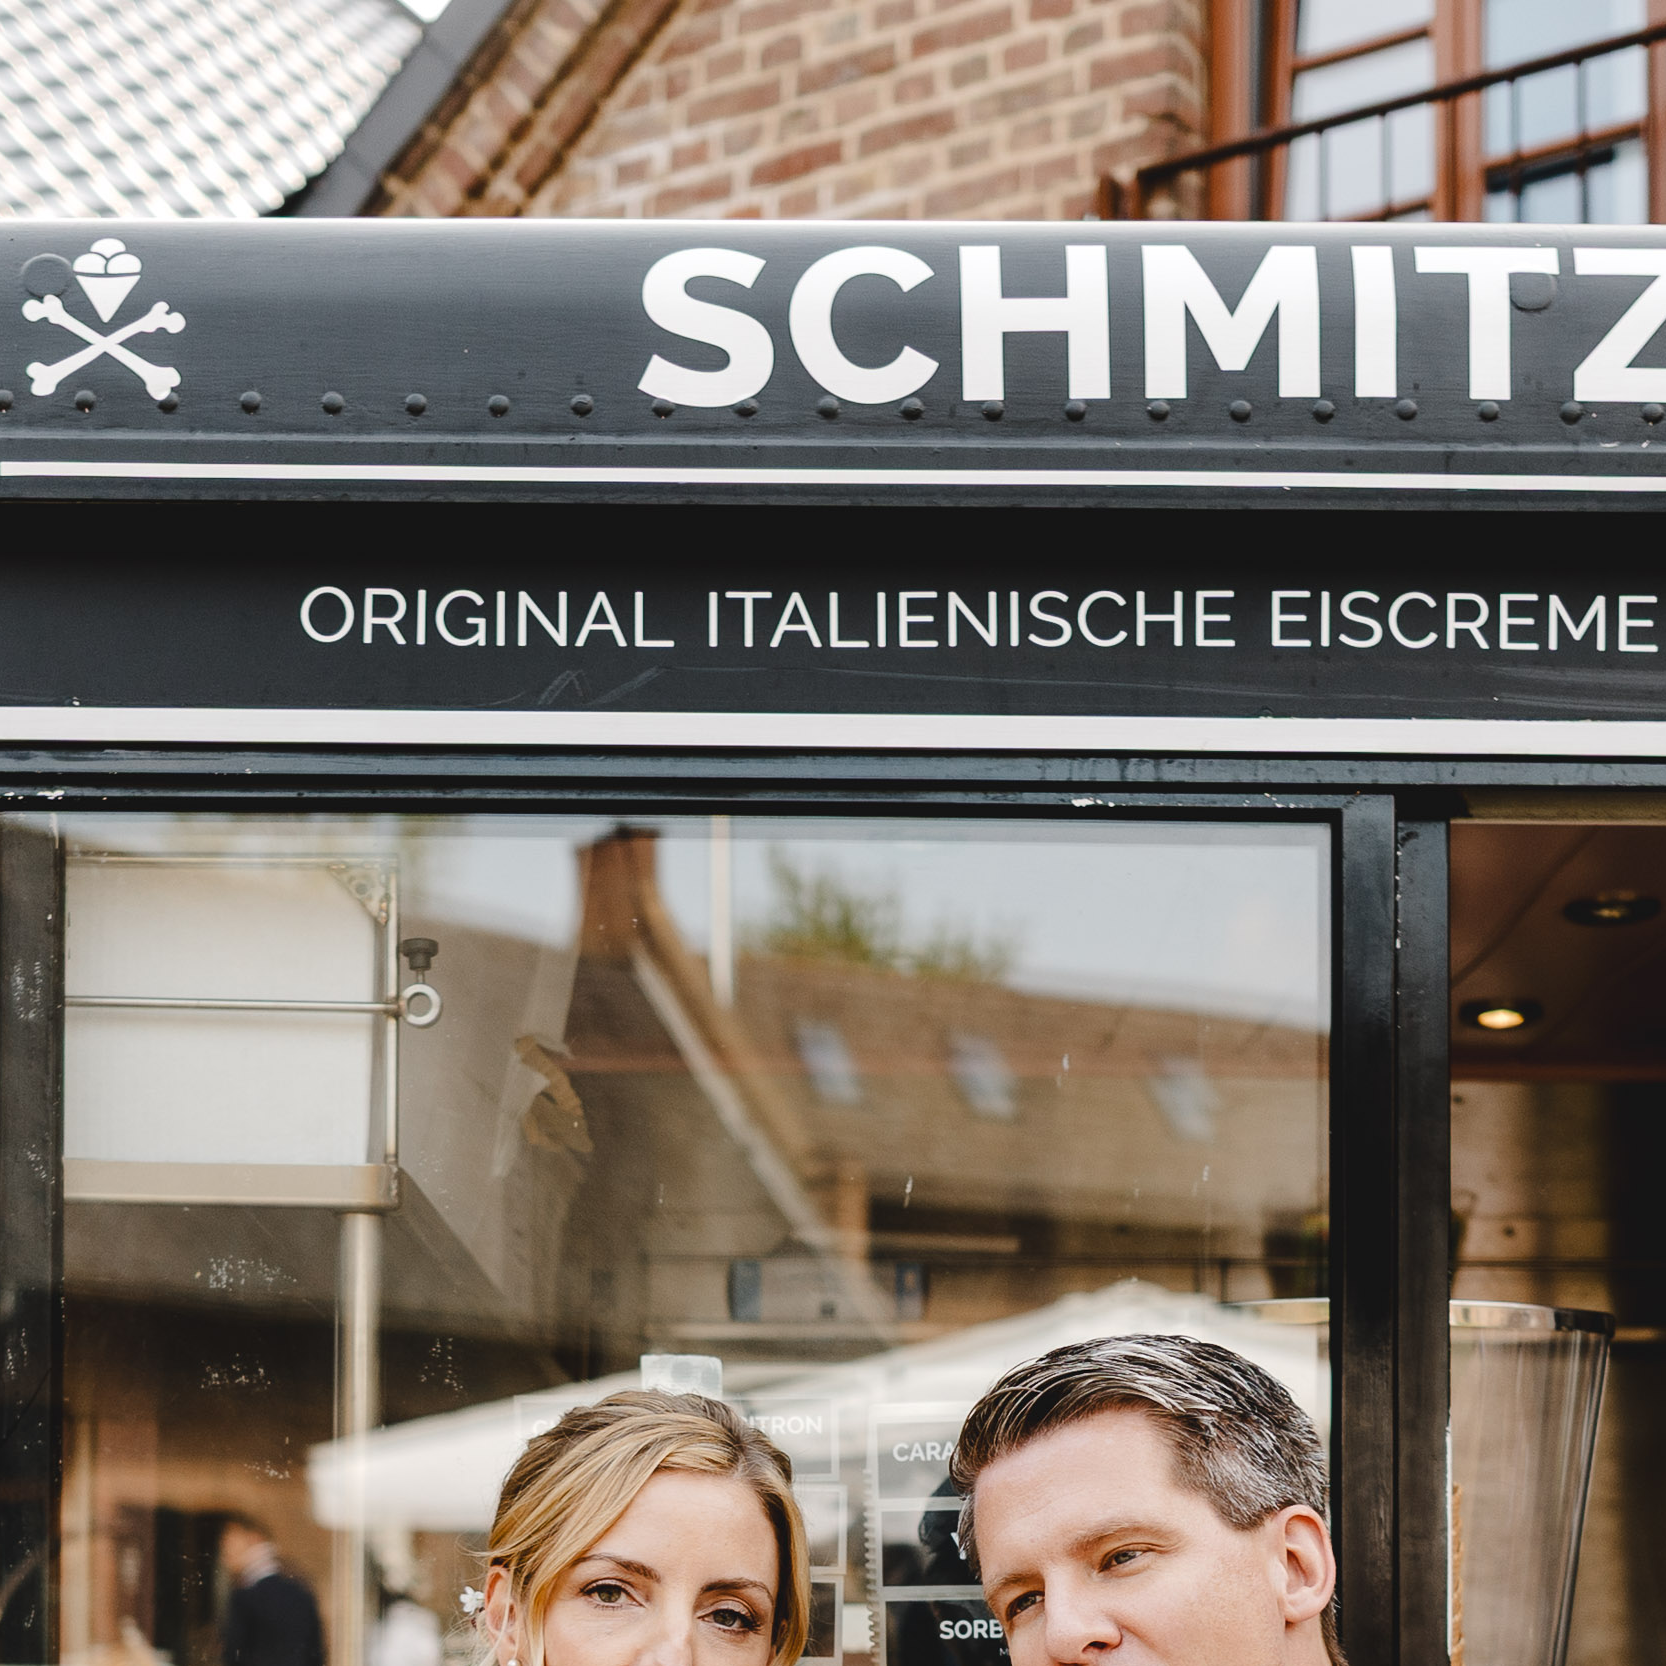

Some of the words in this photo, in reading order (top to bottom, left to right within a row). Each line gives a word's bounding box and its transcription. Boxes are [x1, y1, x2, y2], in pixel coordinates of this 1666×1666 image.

[301, 587, 674, 647] ORIGINAL
[709, 591, 1235, 650] ITALIENISCHE
[1272, 593, 1658, 652] EISCREME
[893, 1441, 957, 1462] CARA
[939, 1618, 1004, 1640] SORB
